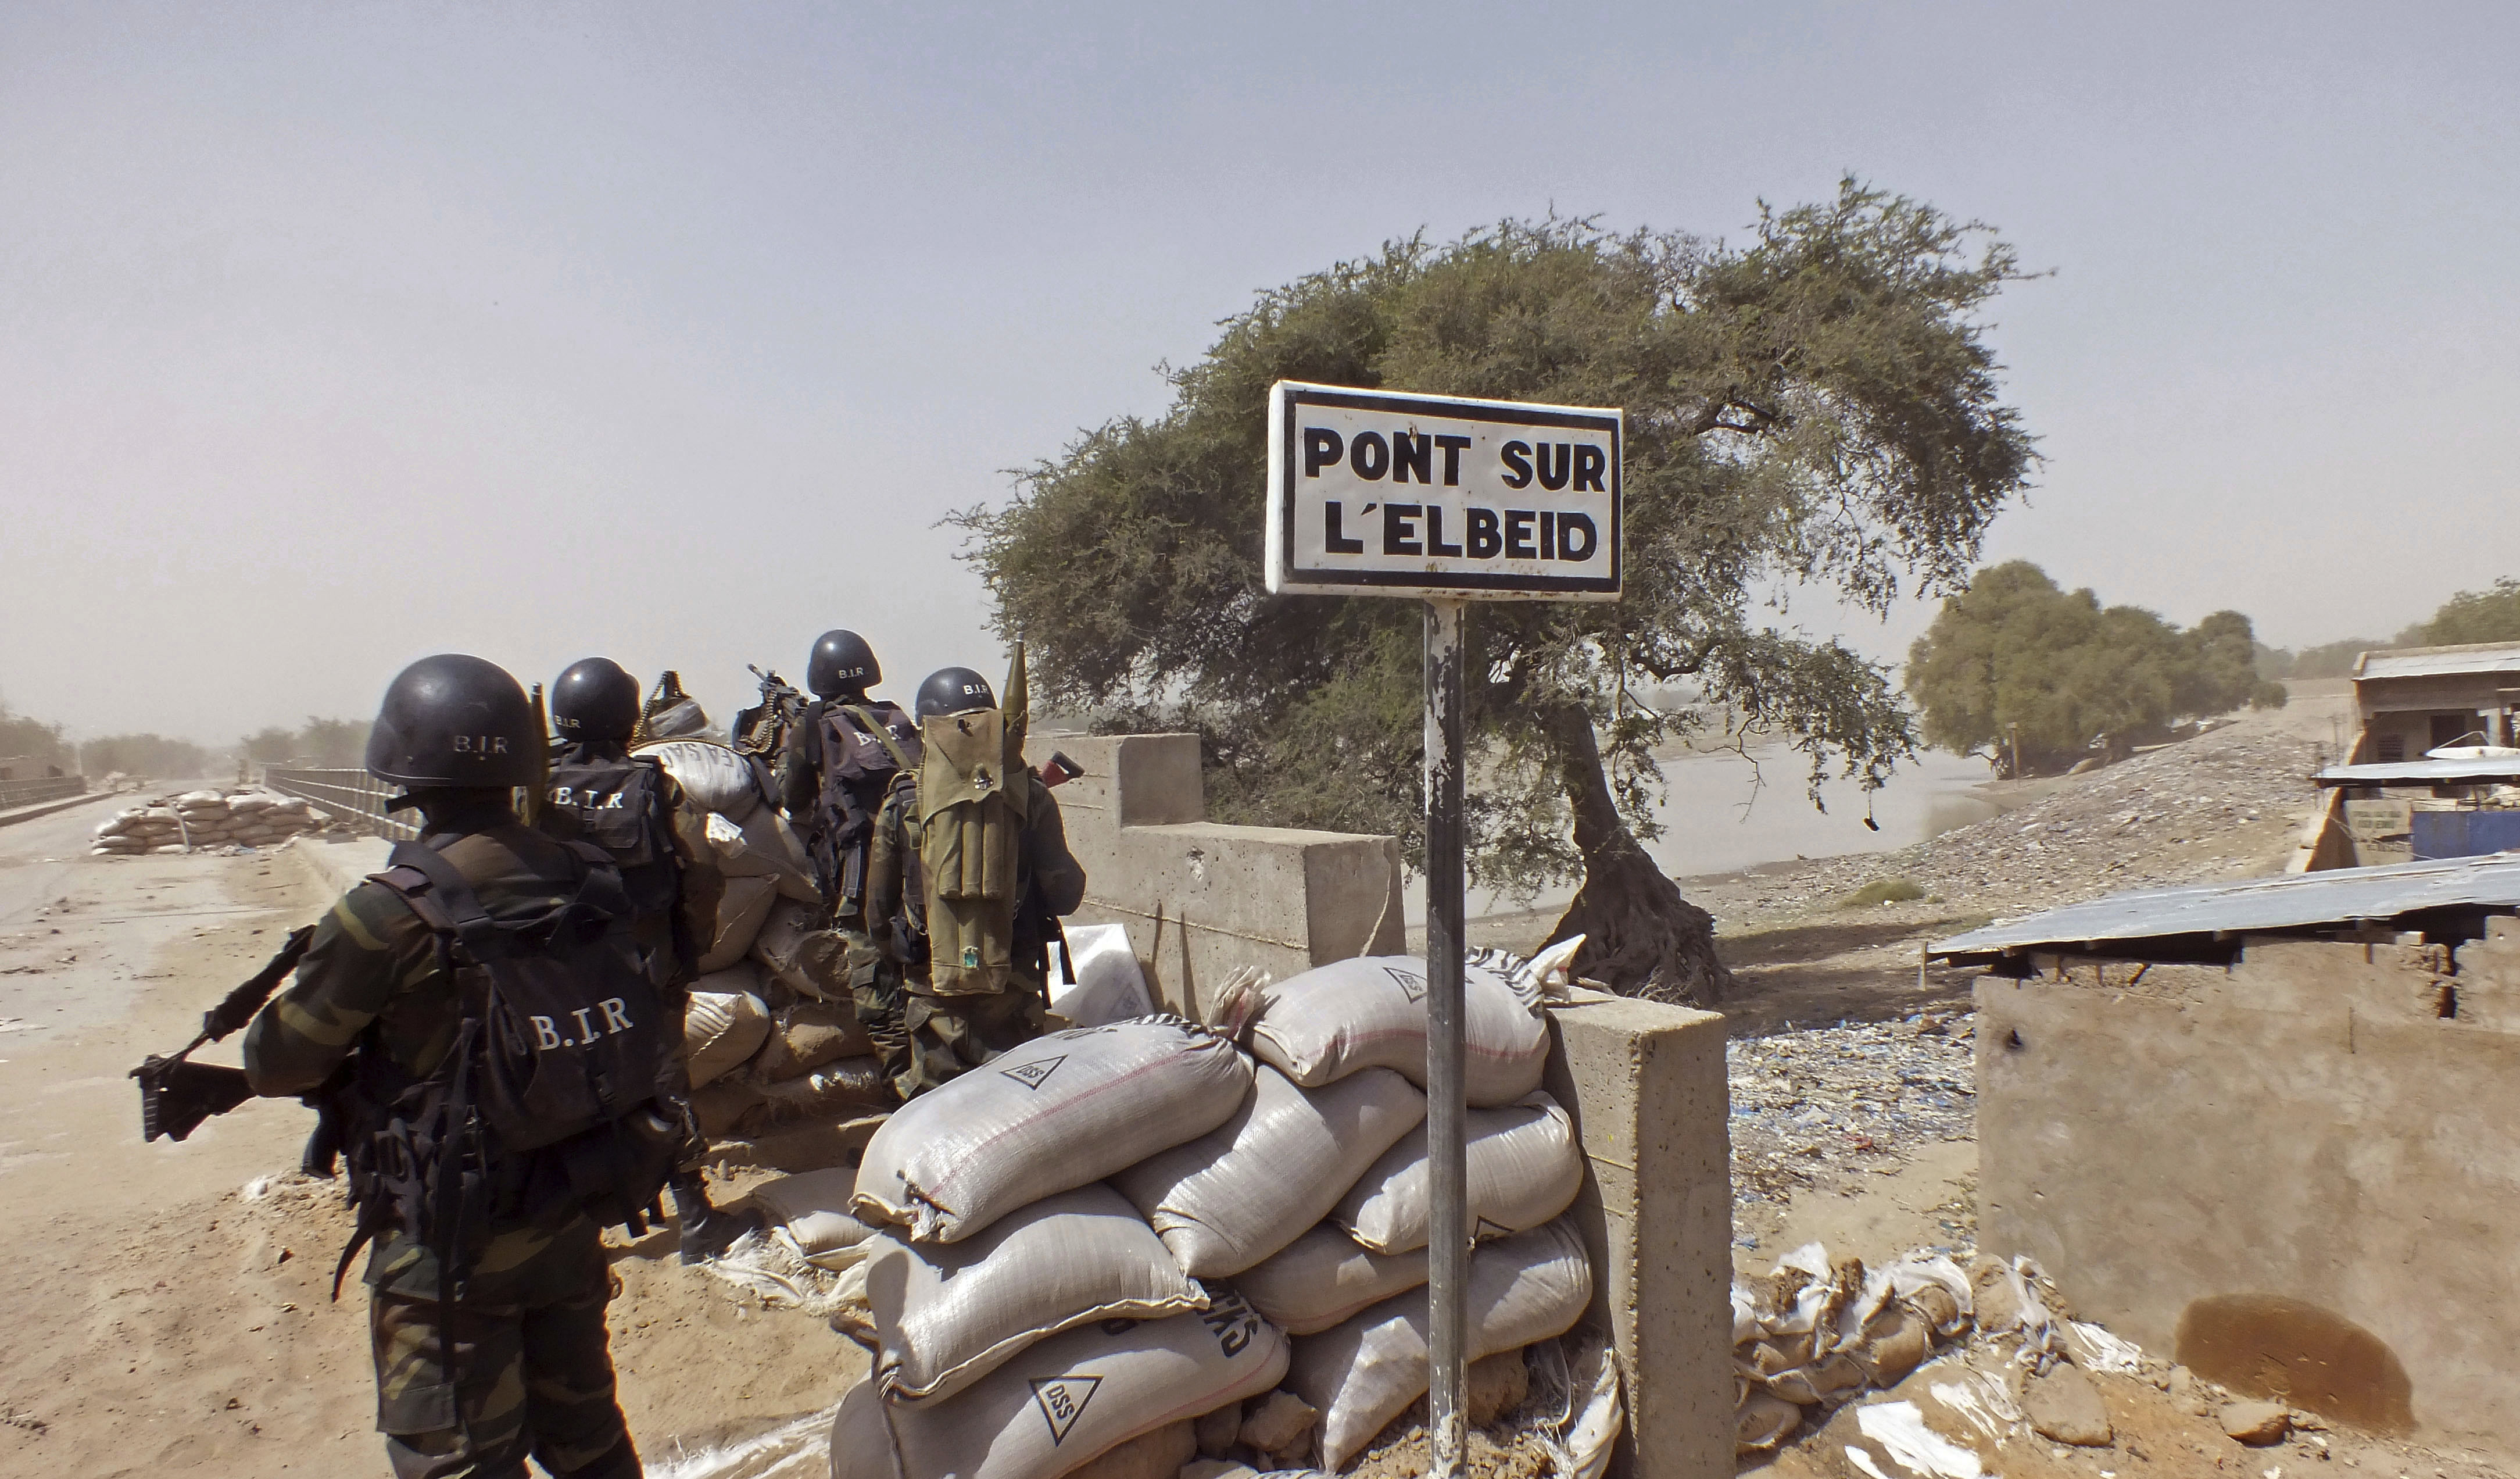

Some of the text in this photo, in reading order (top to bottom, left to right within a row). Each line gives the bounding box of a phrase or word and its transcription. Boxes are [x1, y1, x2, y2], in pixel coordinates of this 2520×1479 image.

[1304, 426, 1606, 492] PONT SUR
[1325, 501, 1598, 562] L'ELBEID
[839, 667, 864, 679] B.I.R
[963, 684, 989, 695] B.I.R
[454, 735, 507, 753] B.I.R
[554, 787, 624, 810] B.I.R
[529, 996, 634, 1051] B.I.R
[1016, 1065, 1045, 1078] DSS
[1046, 1384, 1075, 1419] DSS
